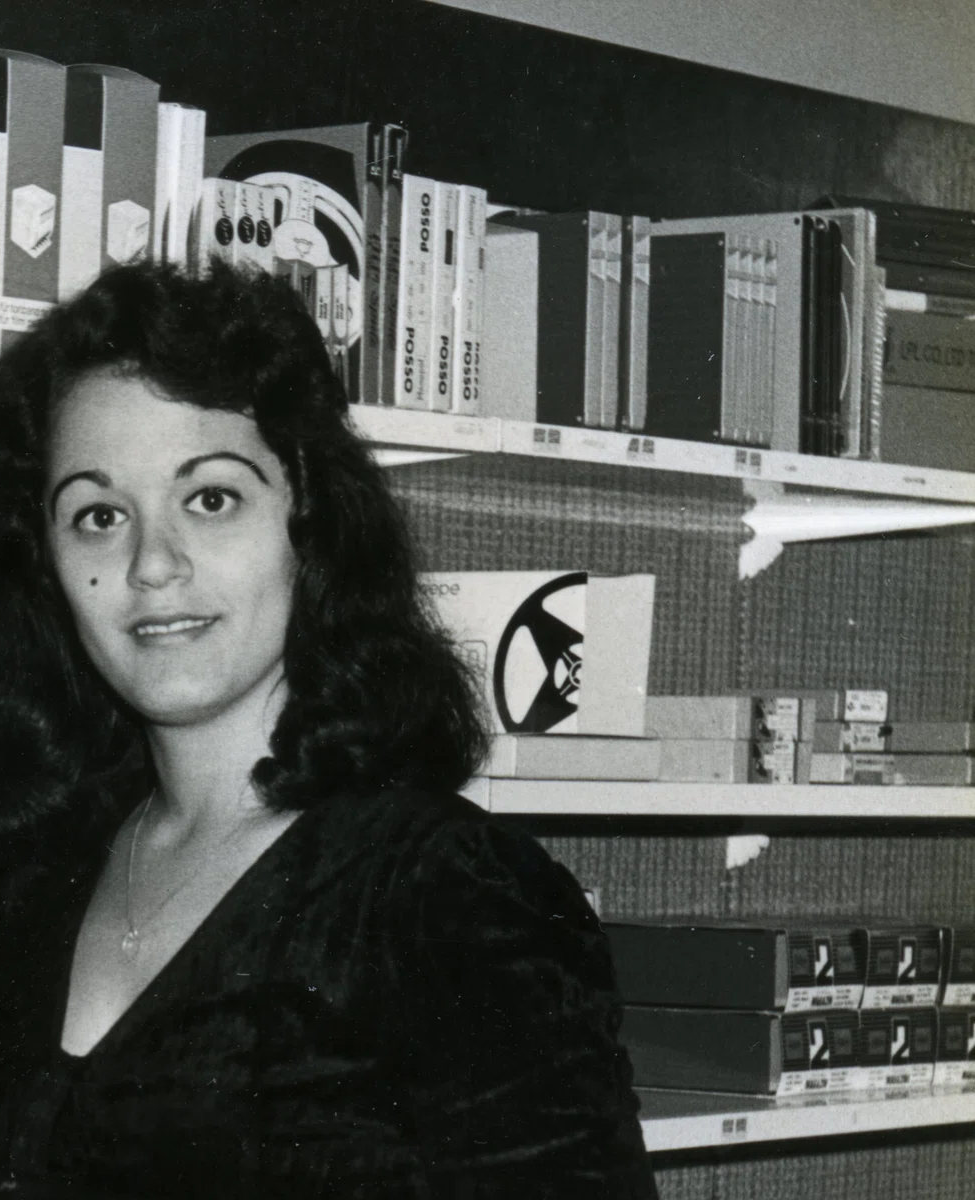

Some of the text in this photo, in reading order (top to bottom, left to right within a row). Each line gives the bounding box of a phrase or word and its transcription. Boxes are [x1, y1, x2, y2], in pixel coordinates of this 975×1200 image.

[420, 192, 431, 252] POSSO
[404, 326, 415, 394] POSSO
[438, 335, 449, 396] POSSO
[463, 340, 472, 401] POSSO
